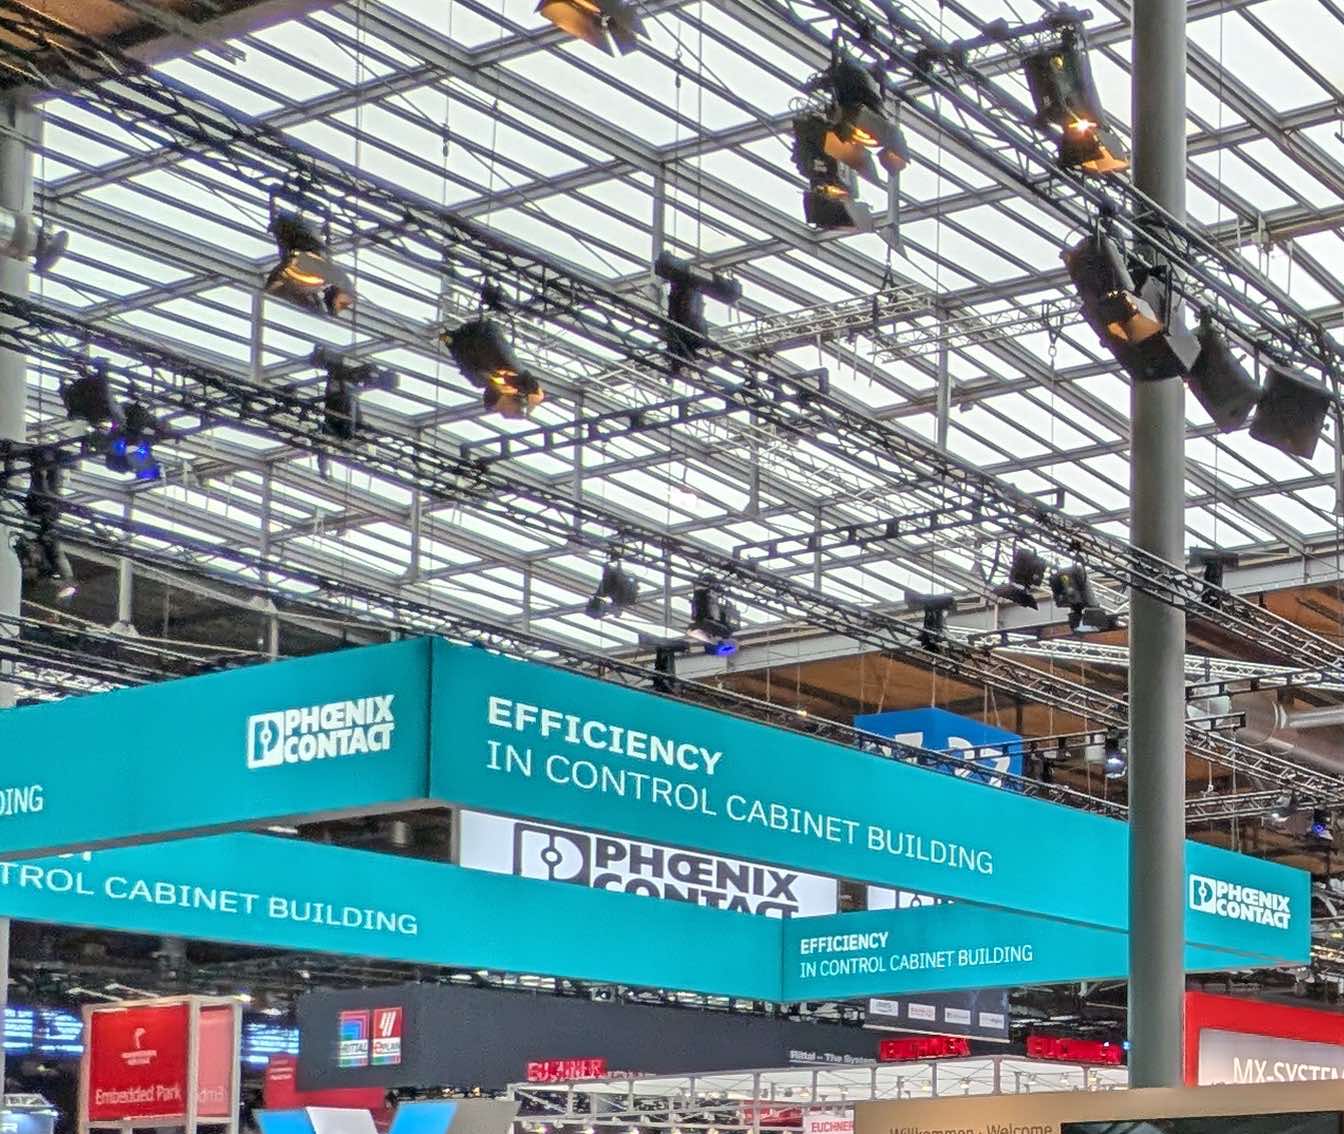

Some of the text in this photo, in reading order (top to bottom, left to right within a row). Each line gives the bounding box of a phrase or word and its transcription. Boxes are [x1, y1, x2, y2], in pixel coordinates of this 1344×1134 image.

[282, 722, 395, 764] CONTACT
[487, 695, 724, 776] EFFICIENCY
[486, 740, 993, 875] IN CONTROL CABINET BUILDING
[104, 875, 260, 914] CABINET
[268, 896, 419, 936] BUILDING
[1216, 898, 1292, 930] CONTACT
[800, 932, 889, 955] EFFICIENCY
[800, 944, 1033, 979] IN CONTROL CABINET BUILDING
[95, 1085, 154, 1105] Embedded
[156, 1082, 182, 1102] Park
